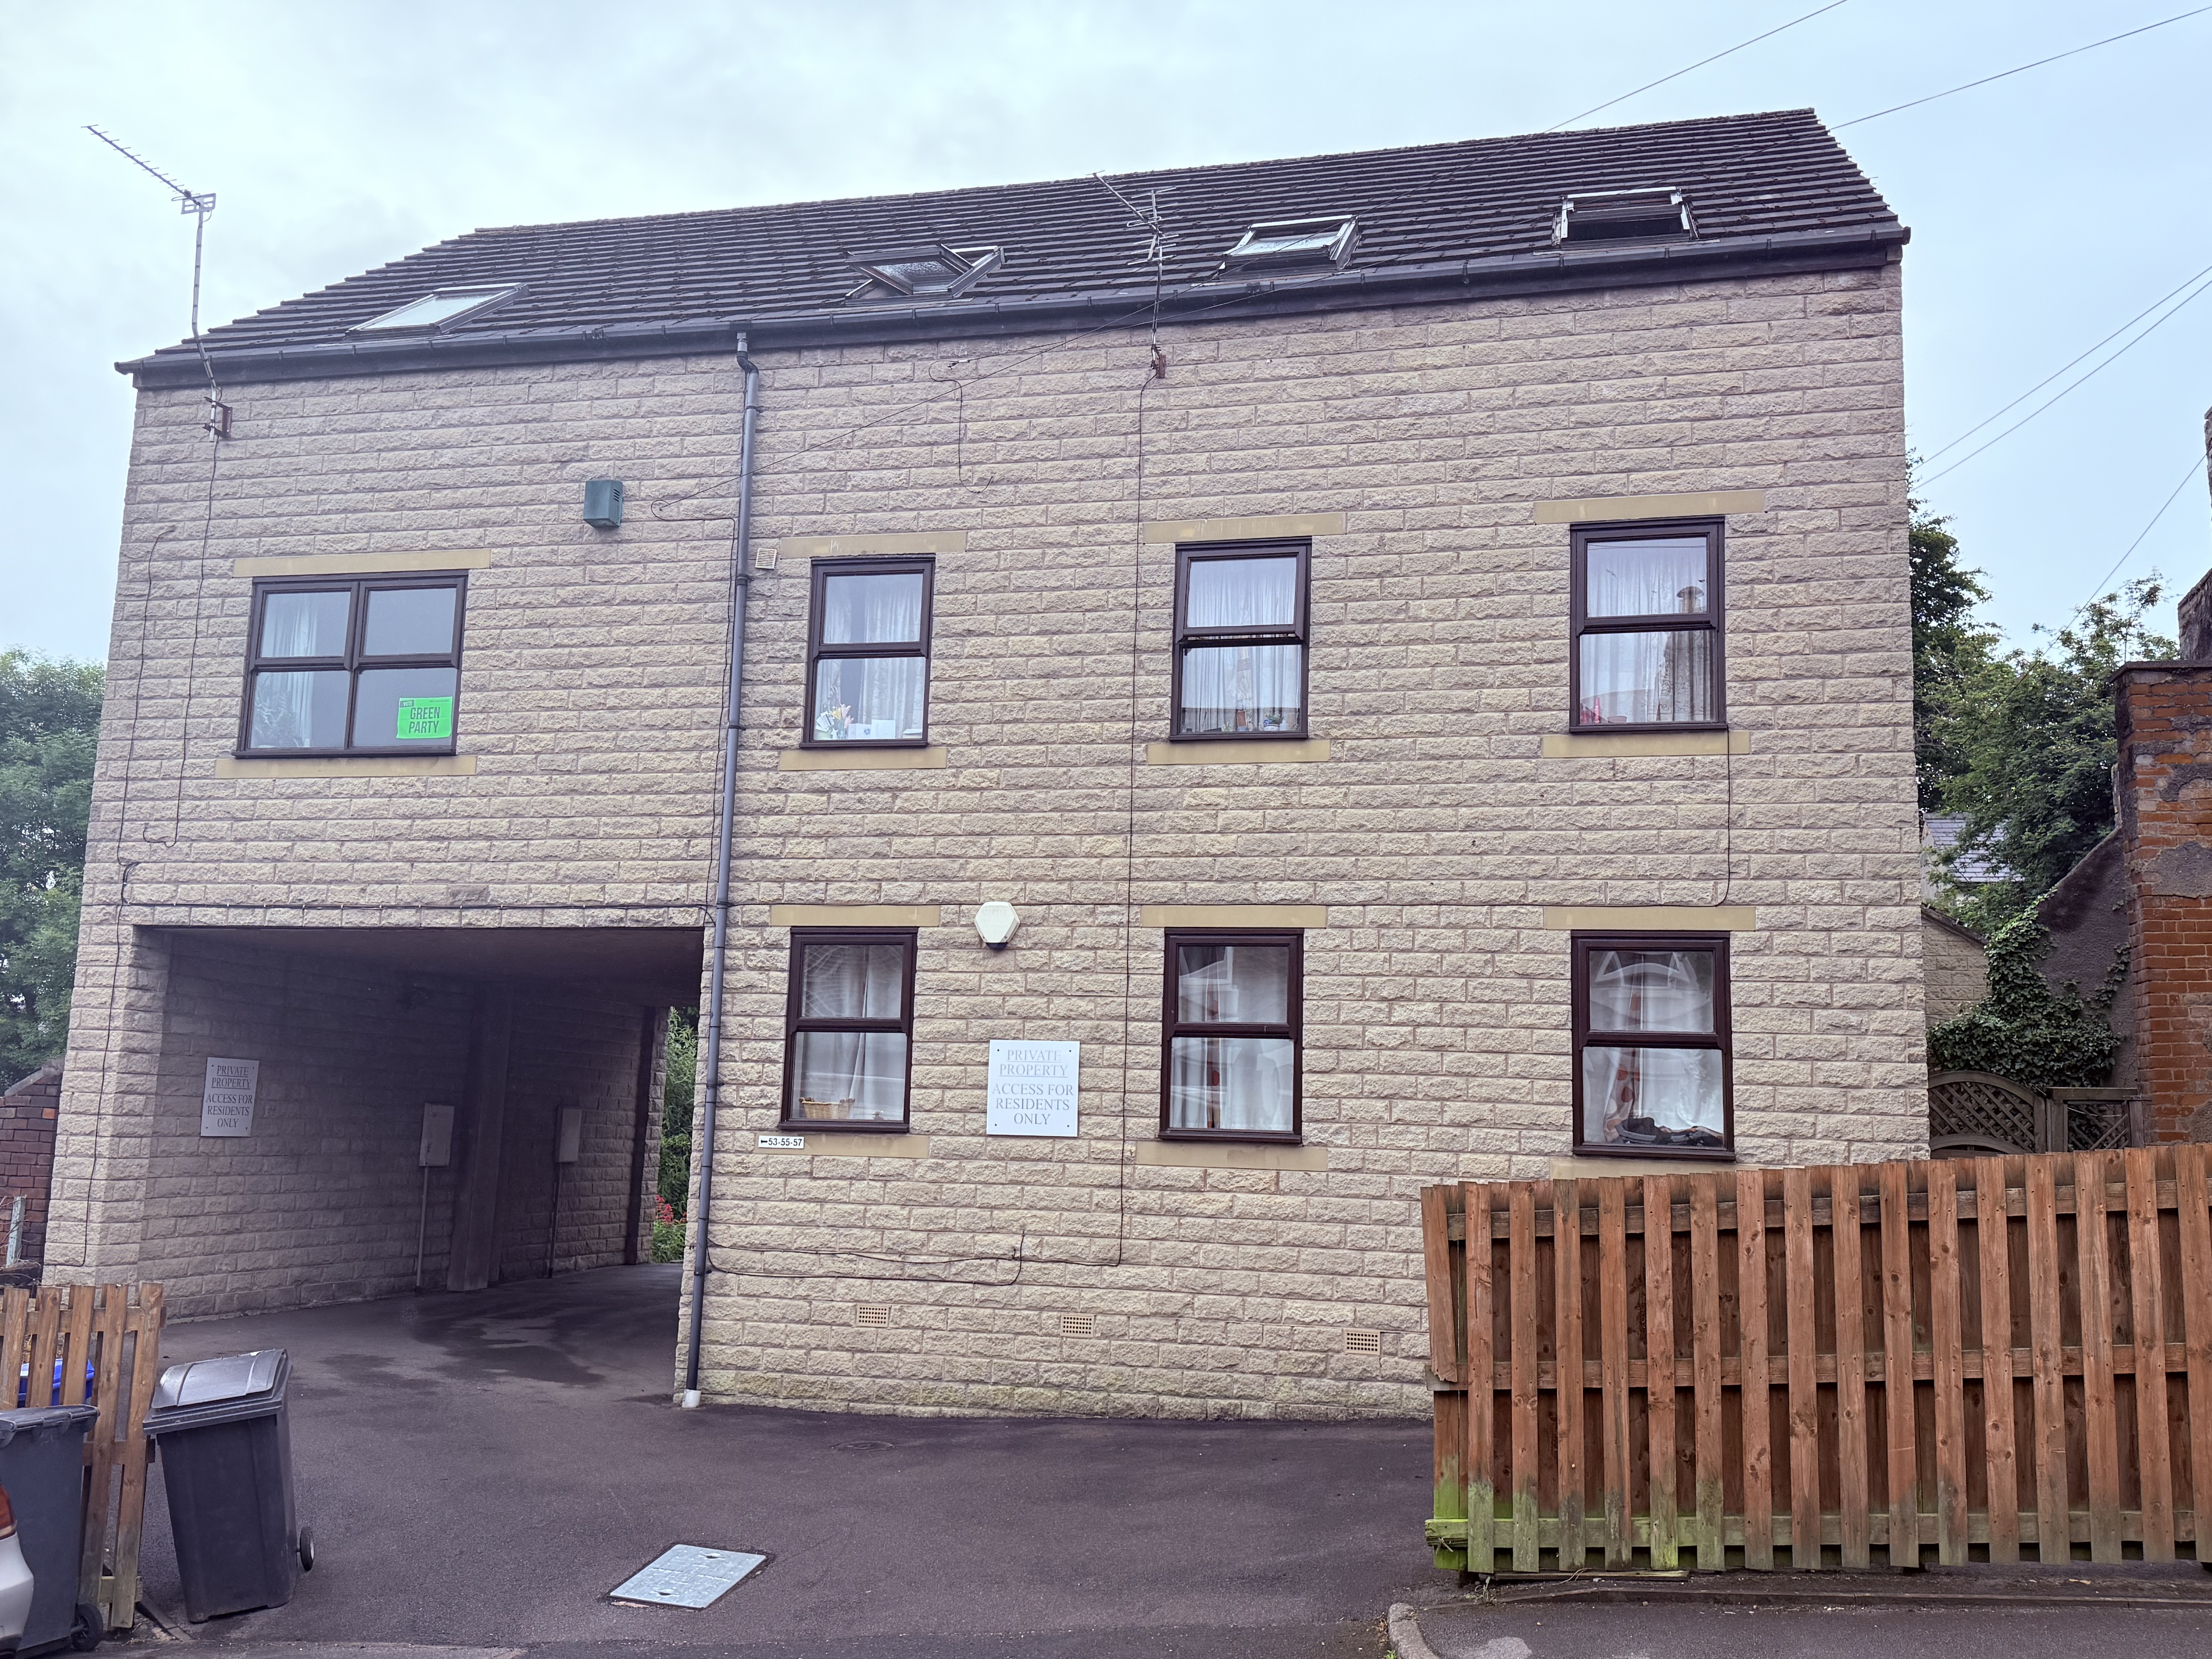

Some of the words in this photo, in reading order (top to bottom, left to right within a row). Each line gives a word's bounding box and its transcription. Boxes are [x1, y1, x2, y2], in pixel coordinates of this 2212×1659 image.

[410, 707, 440, 719] GREEN
[409, 721, 439, 733] PARTY
[1007, 1049, 1061, 1061] PRIVATE
[217, 1065, 249, 1076] PRIVATE
[1000, 1064, 1068, 1076] PROPERTY
[212, 1078, 251, 1088] PROPERTY
[992, 1084, 1043, 1095] ACCESS
[1048, 1084, 1074, 1096] FOR
[206, 1094, 236, 1103] ACCESS
[239, 1094, 252, 1104] FOR
[996, 1098, 1069, 1110] RESIDENTS
[208, 1106, 250, 1116] RESIDENTS
[217, 1118, 239, 1128] ONLY
[1014, 1113, 1051, 1125] ONLY
[768, 1138, 802, 1146] 53-55-57
